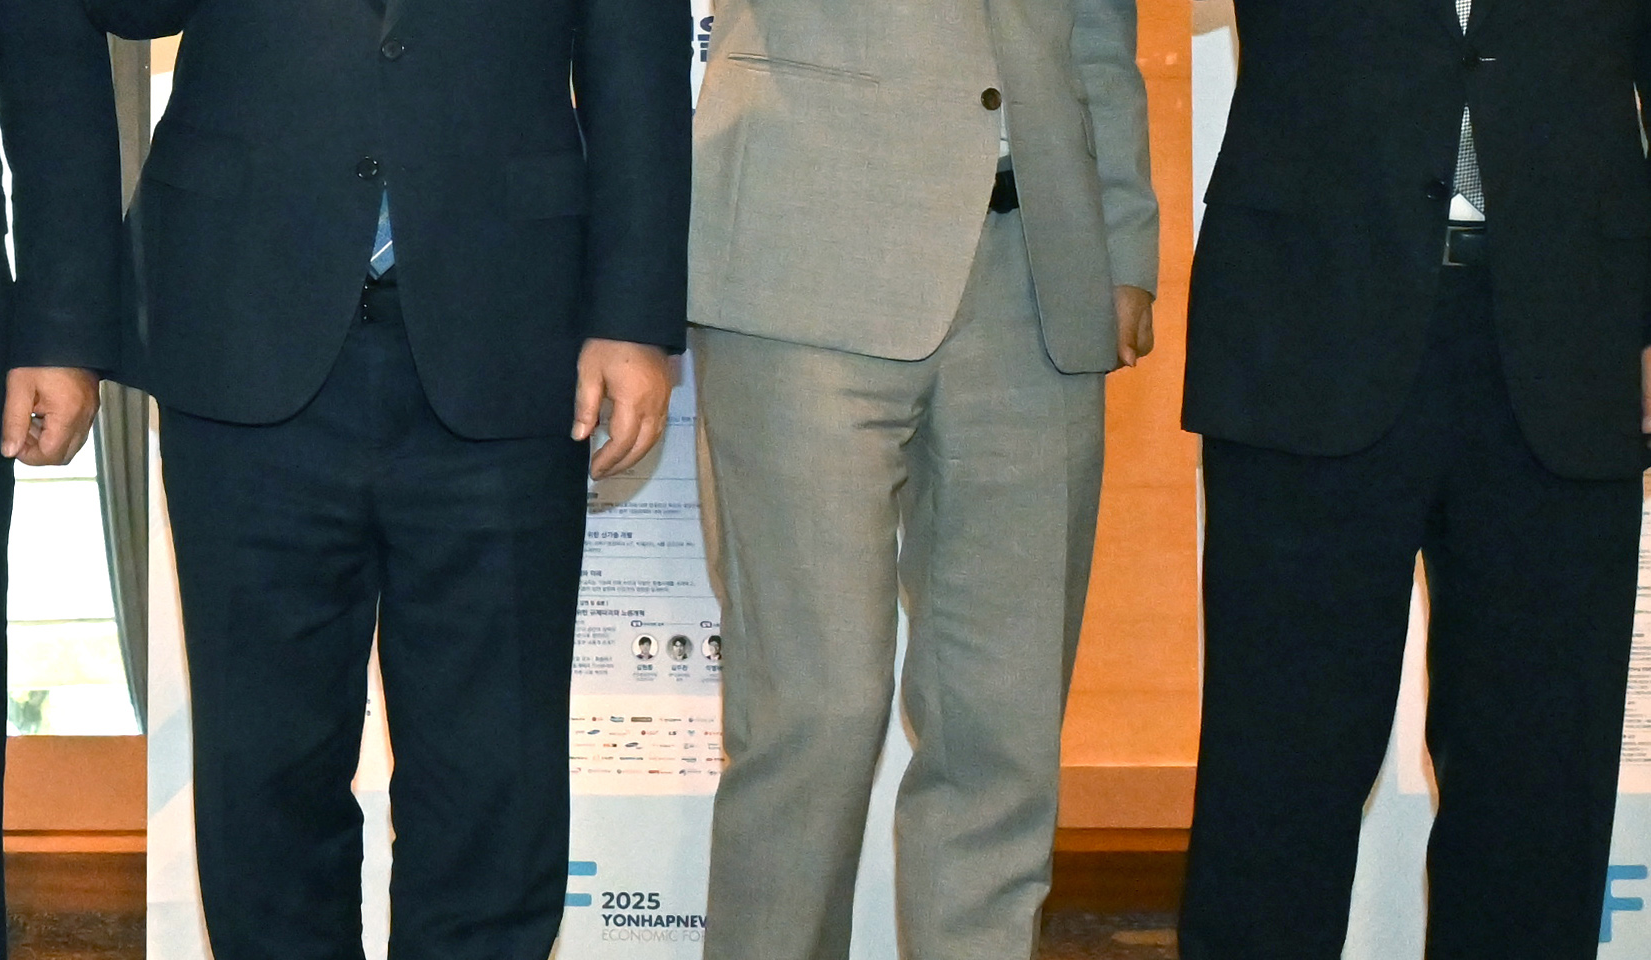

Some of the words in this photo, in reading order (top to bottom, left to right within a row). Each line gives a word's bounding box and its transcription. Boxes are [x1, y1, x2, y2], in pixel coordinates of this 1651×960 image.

[601, 891, 661, 910] 2025
[602, 930, 678, 941] ECONOMIC
[683, 930, 706, 941] FO
